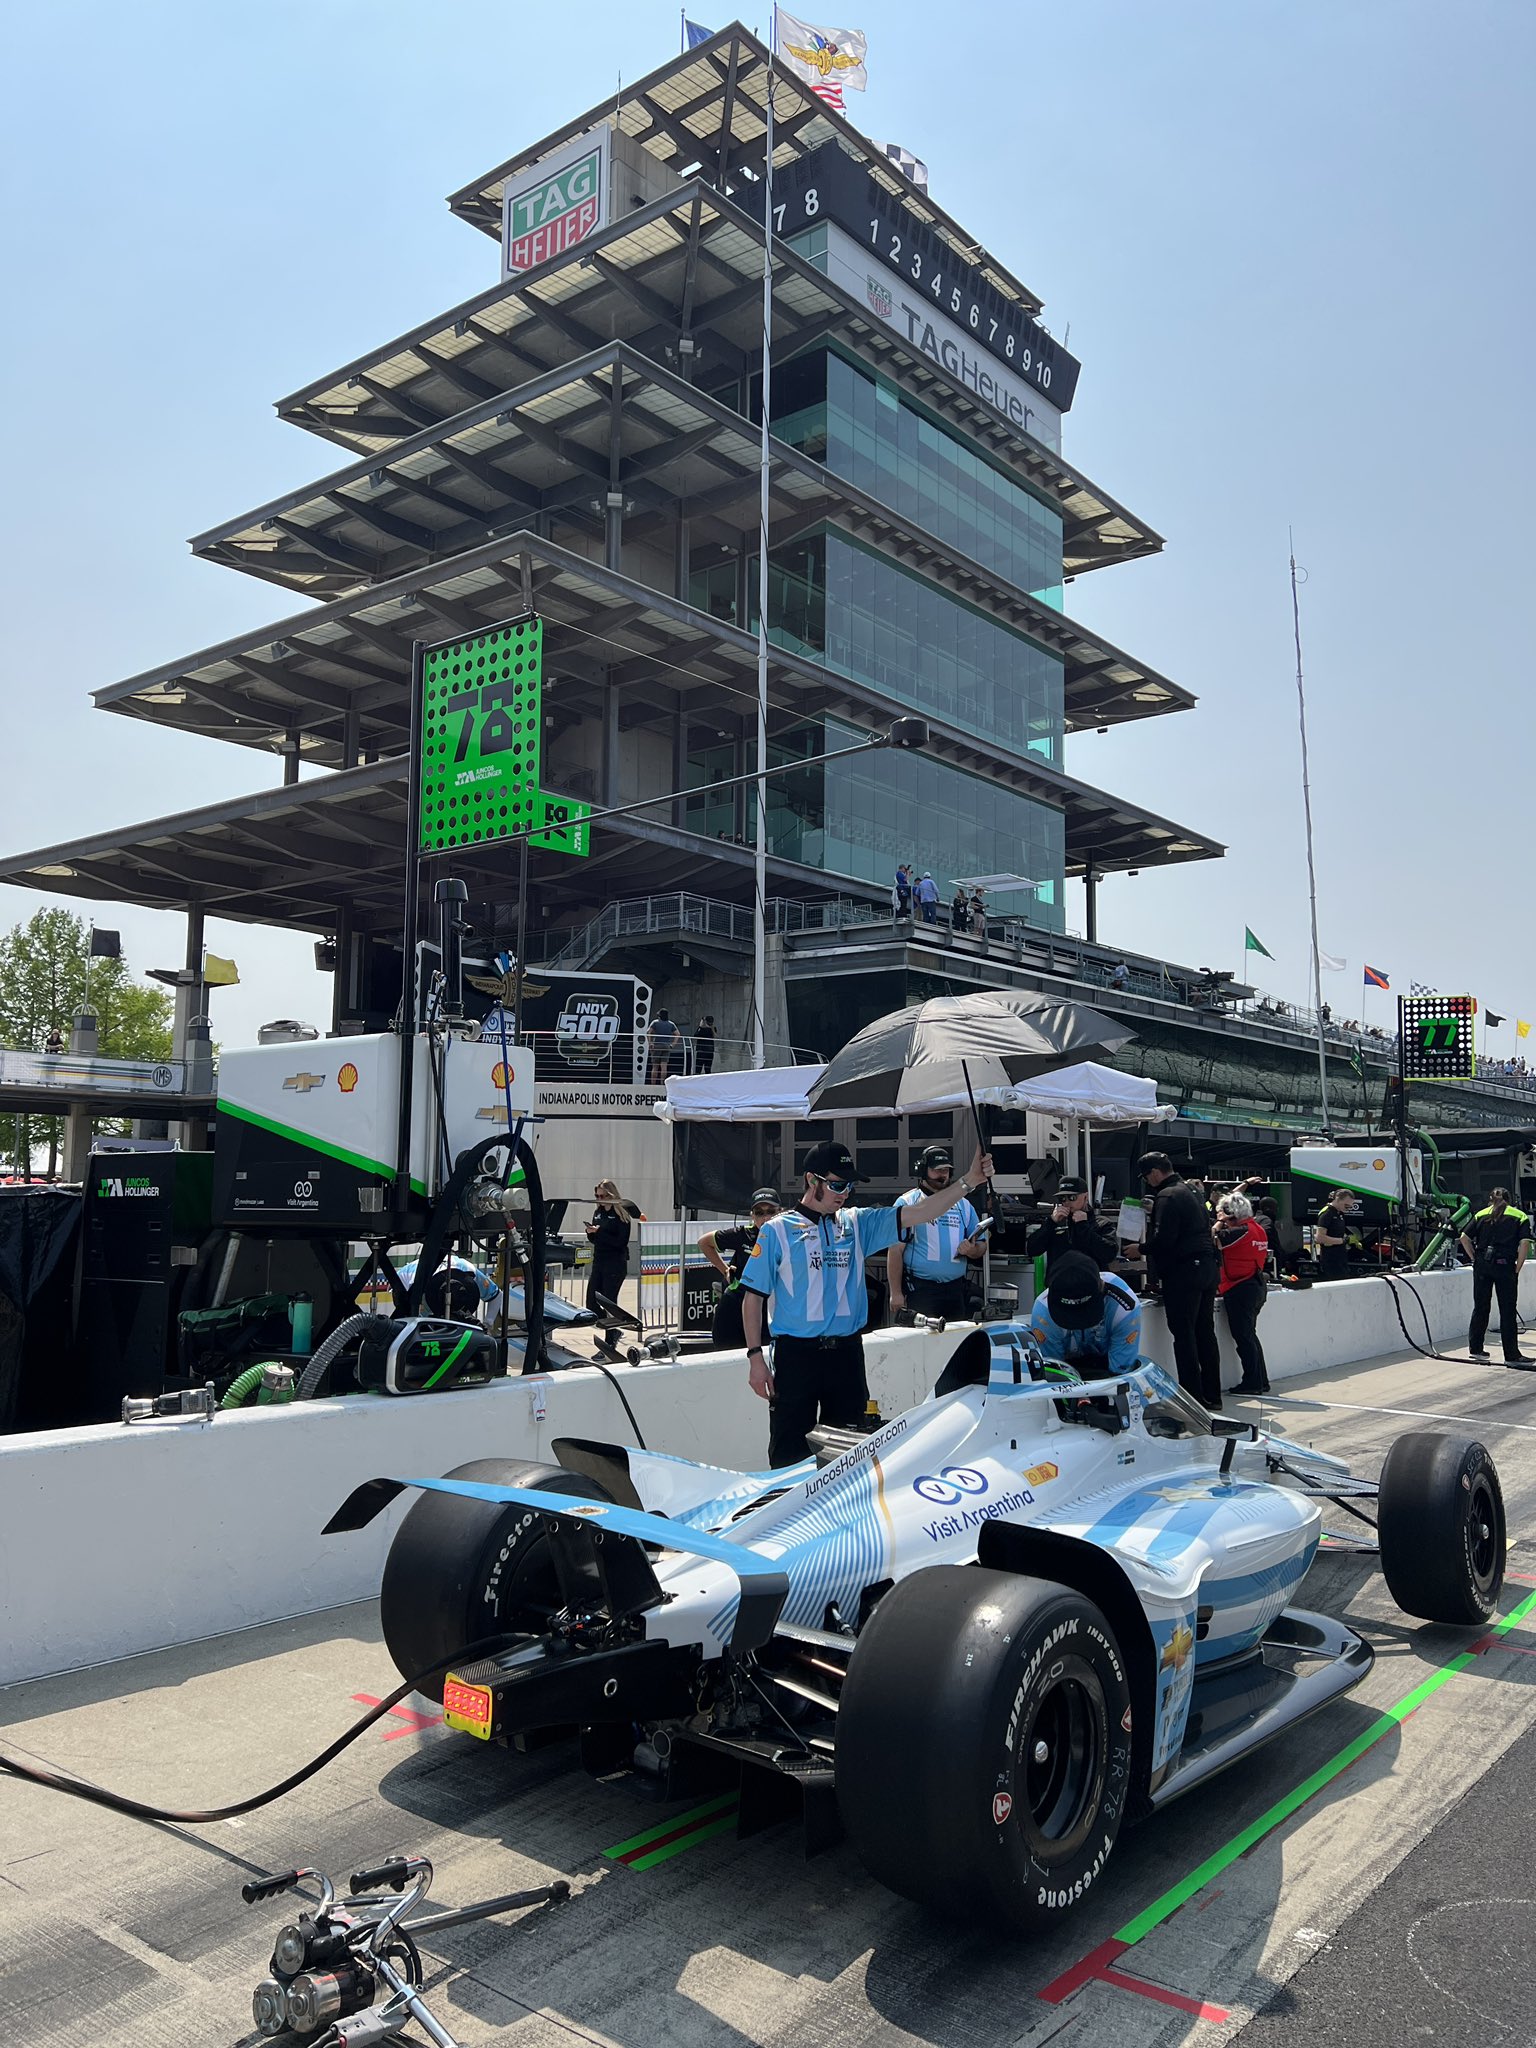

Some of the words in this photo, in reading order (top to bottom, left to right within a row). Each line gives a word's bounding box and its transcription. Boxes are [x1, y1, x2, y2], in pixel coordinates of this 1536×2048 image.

[518, 164, 590, 228] TAG
[772, 203, 787, 233] 7
[804, 188, 819, 216] 8
[514, 201, 593, 265] HEUER
[869, 280, 890, 304] TAG
[870, 218, 879, 244] 1
[888, 235, 902, 264] 2
[911, 253, 922, 279] 3
[931, 273, 942, 297] 4
[950, 287, 962, 312] 5
[969, 304, 980, 328] 6
[989, 318, 999, 342] 7
[1005, 334, 1015, 358] 8
[1022, 348, 1032, 371] 9
[1036, 361, 1051, 389] 10
[447, 679, 514, 763] 78
[576, 1003, 609, 1015] INDY
[558, 1015, 618, 1041] 500
[1418, 1017, 1458, 1047] 77
[156, 1069, 171, 1087] IMS
[539, 1092, 600, 1105] INDIANAPOLIS
[602, 1093, 633, 1106] MOTOR
[124, 1186, 160, 1197] HOLLINGER
[126, 1177, 150, 1187] JUNCOS
[687, 1290, 710, 1305] THE
[687, 1305, 704, 1320] OF
[421, 1341, 441, 1357] 78
[805, 1419, 908, 1499] JuncosHollinger.com
[922, 1517, 963, 1543] Visit
[1005, 1618, 1080, 1752] FIREHAWK
[1037, 1834, 1114, 1909] Firestone
